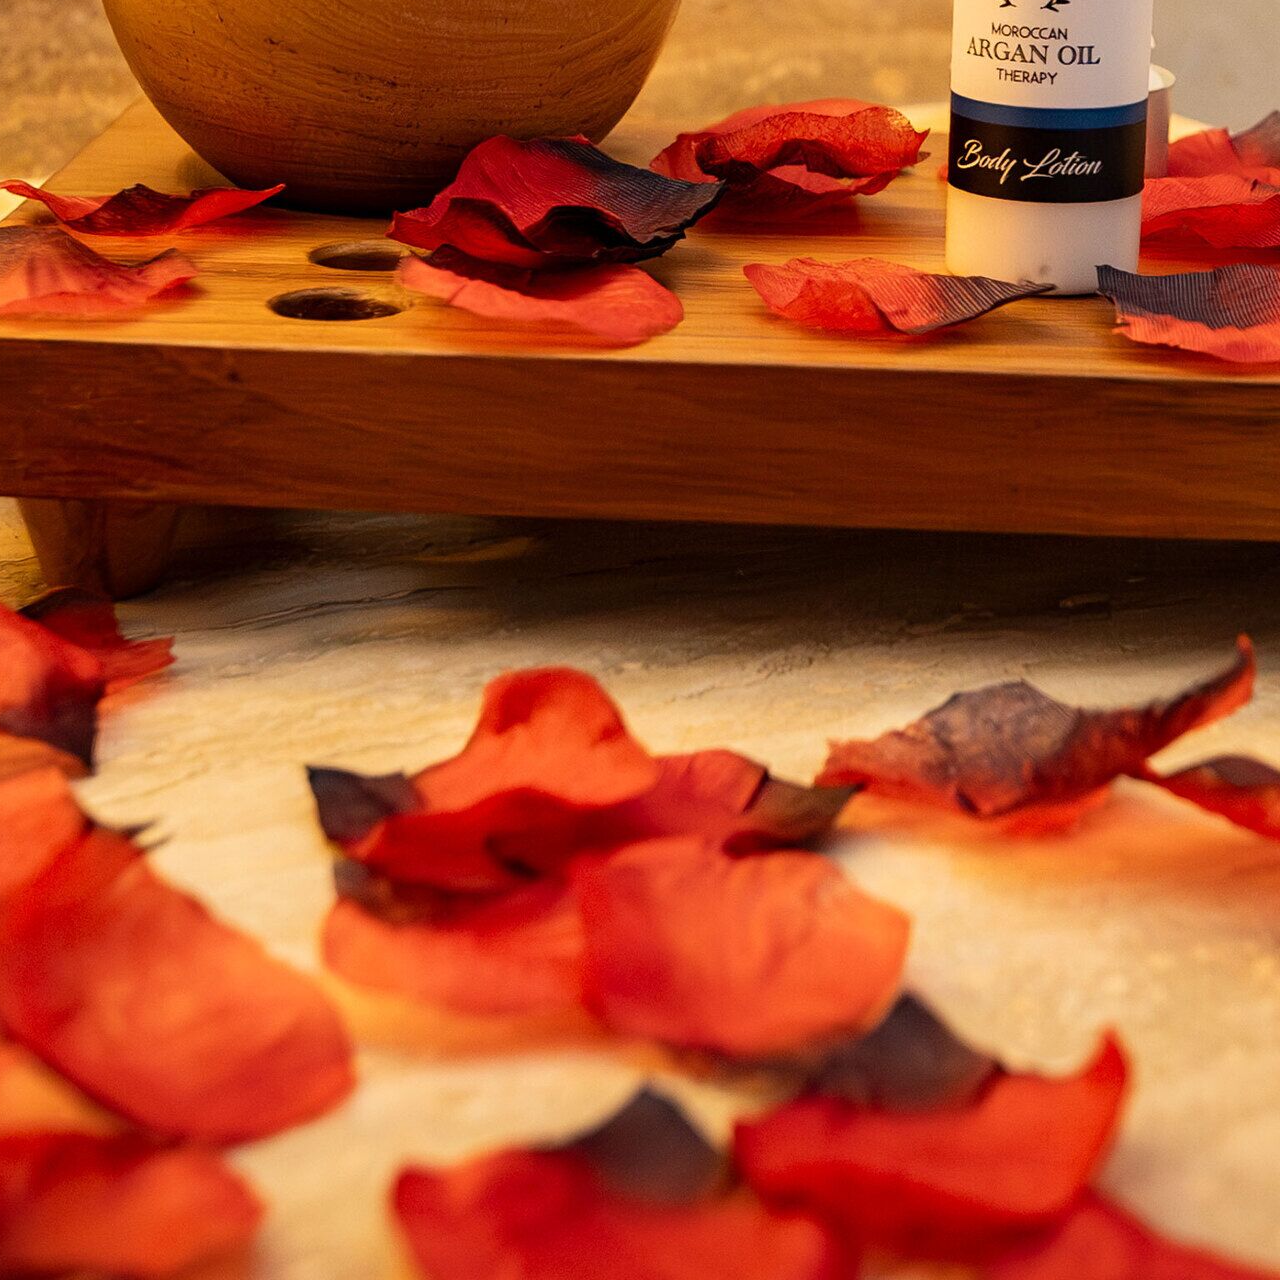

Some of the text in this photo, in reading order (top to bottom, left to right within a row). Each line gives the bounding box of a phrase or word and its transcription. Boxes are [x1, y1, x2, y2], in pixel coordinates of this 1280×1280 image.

[991, 22, 1068, 40] MOROCCAN
[966, 36, 1101, 66] ARGAN OIL
[996, 67, 1058, 85] THERAPY
[957, 139, 1104, 185] Body Lotion
